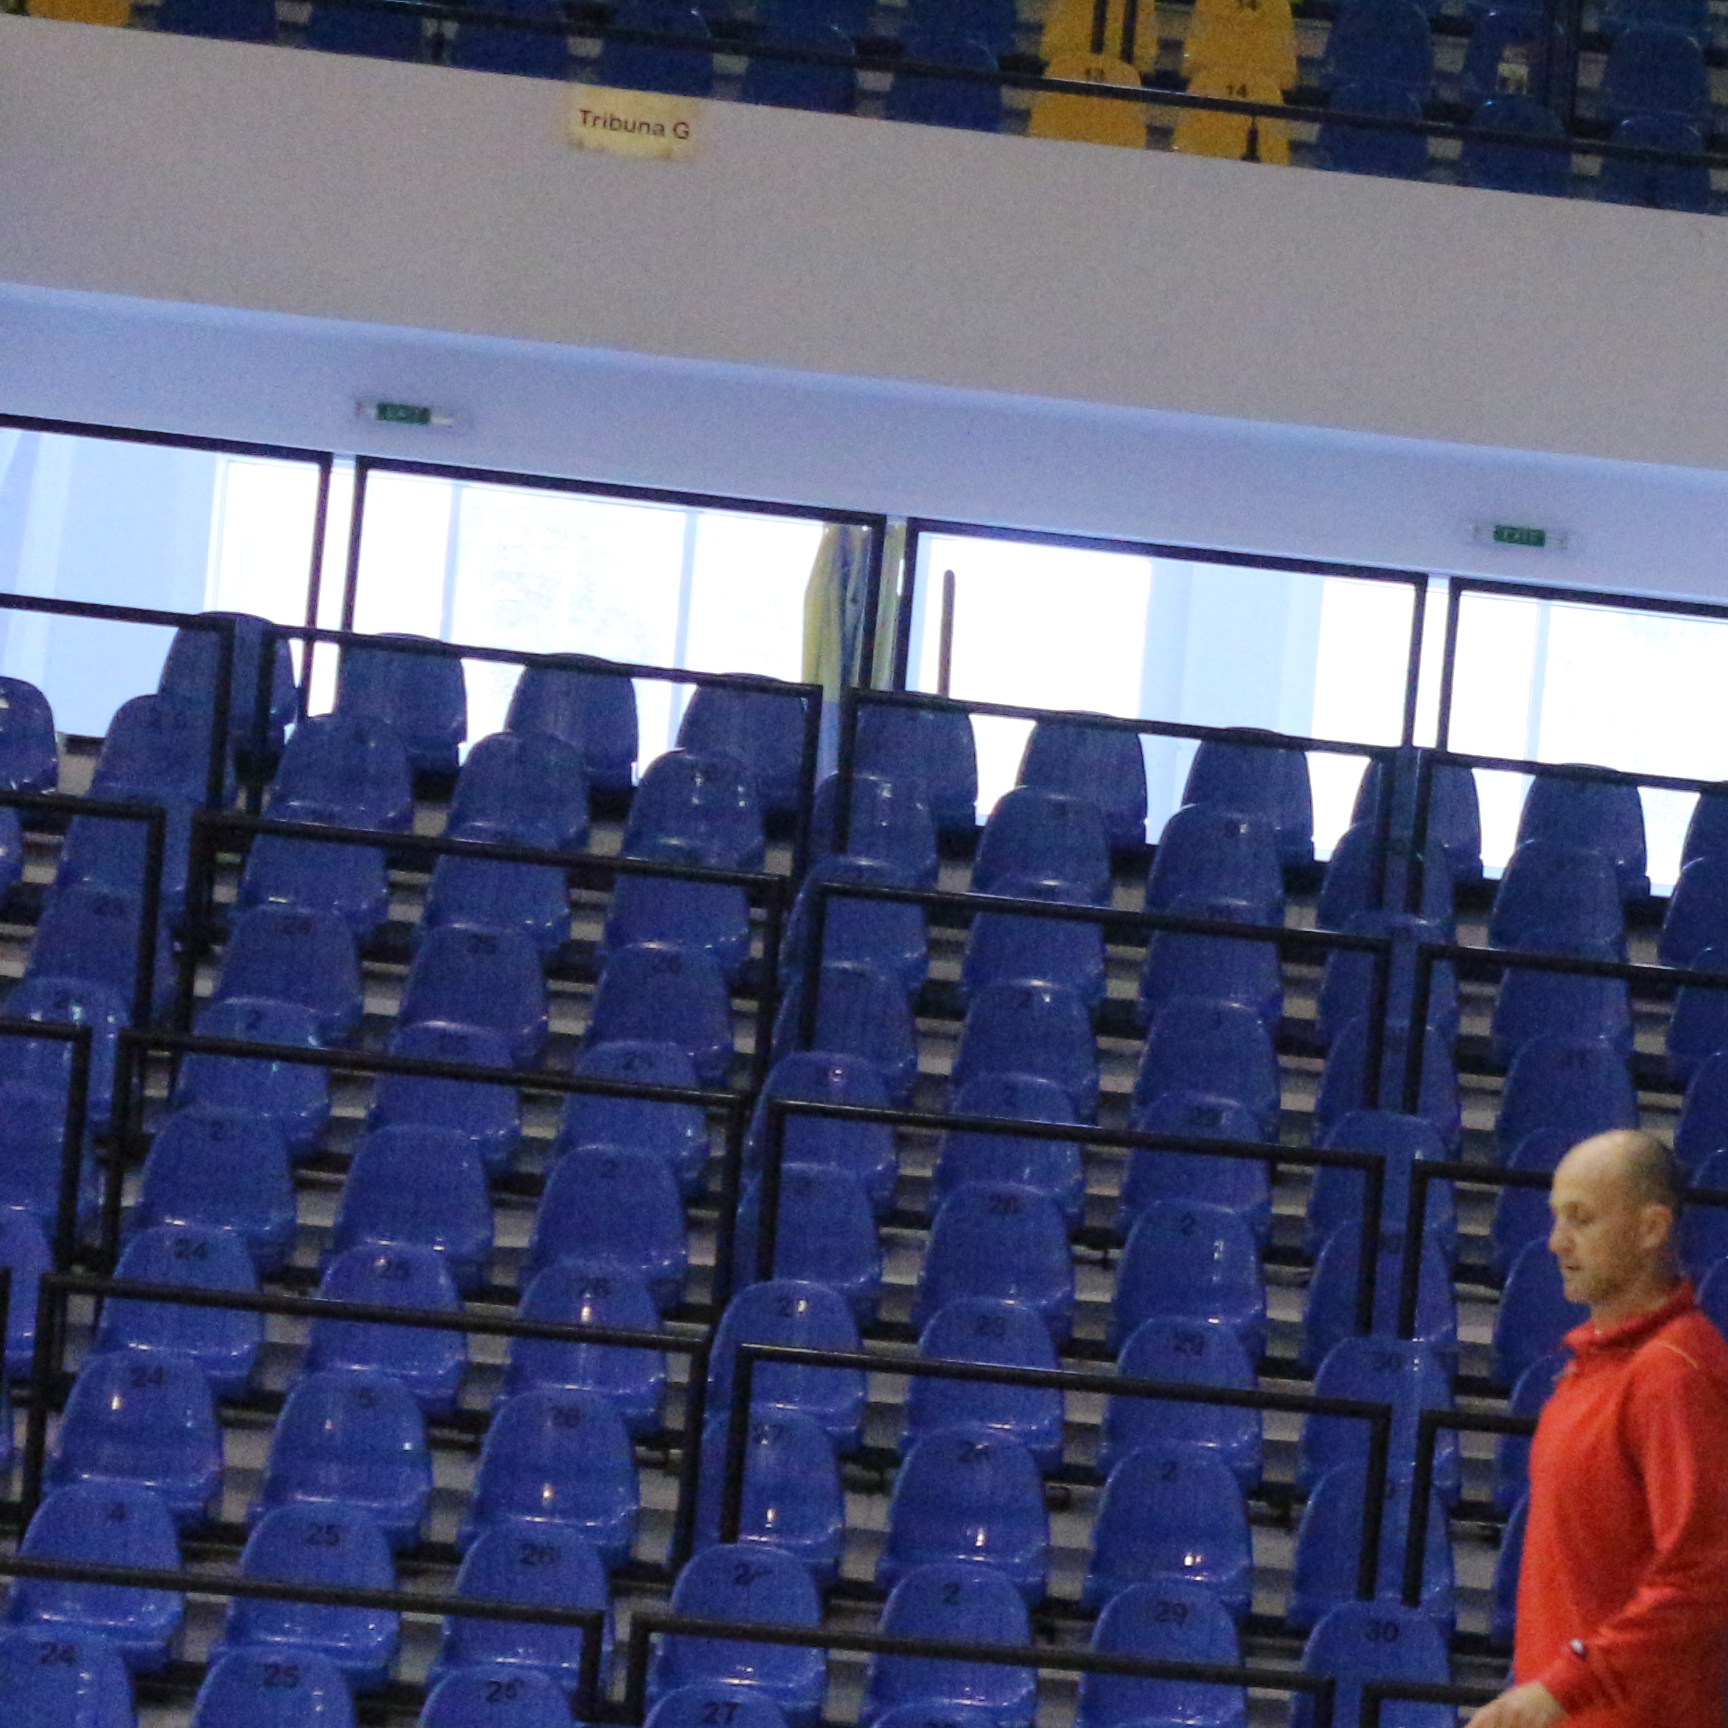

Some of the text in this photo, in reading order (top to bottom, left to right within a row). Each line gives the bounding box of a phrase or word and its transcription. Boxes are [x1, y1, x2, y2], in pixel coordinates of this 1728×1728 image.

[579, 108, 690, 139] Tribuna G
[306, 1522, 340, 1546] 25
[1365, 1620, 1399, 1643] 30
[263, 1662, 299, 1689] 25
[703, 1700, 740, 1725] 27
